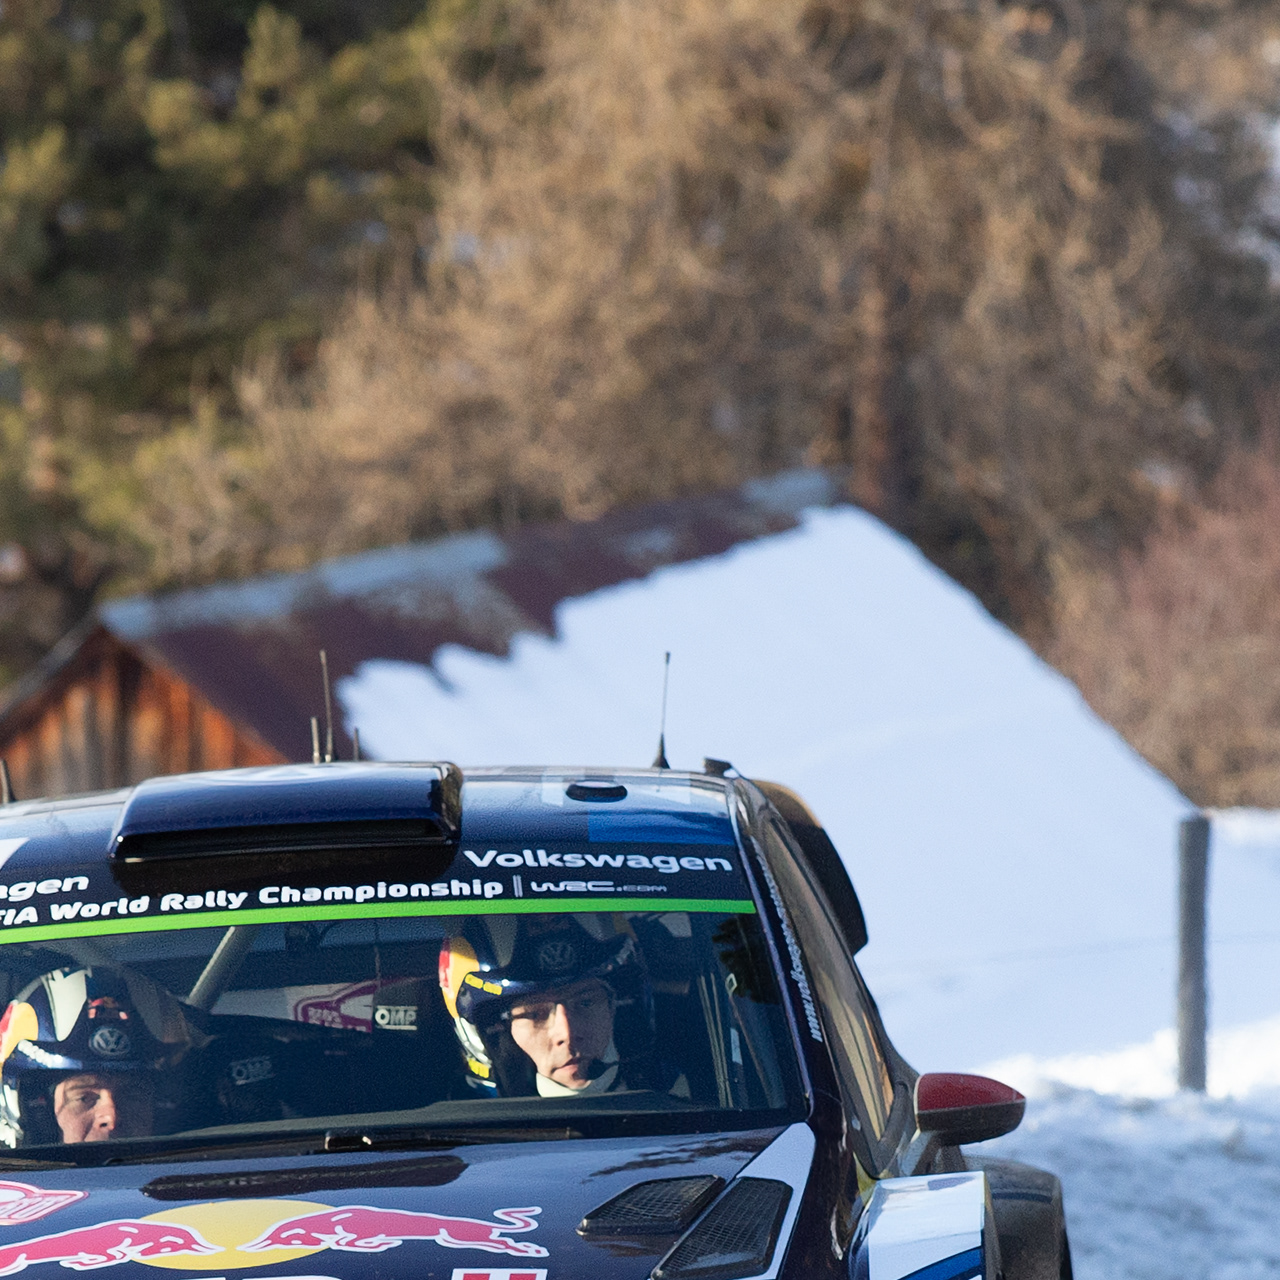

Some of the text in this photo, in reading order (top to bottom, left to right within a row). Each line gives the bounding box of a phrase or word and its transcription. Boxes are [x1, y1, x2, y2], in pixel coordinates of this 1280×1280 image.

[462, 849, 734, 875] Volkswagen
[49, 896, 150, 921] World
[160, 890, 249, 913] Rally
[257, 878, 504, 905] Championship
